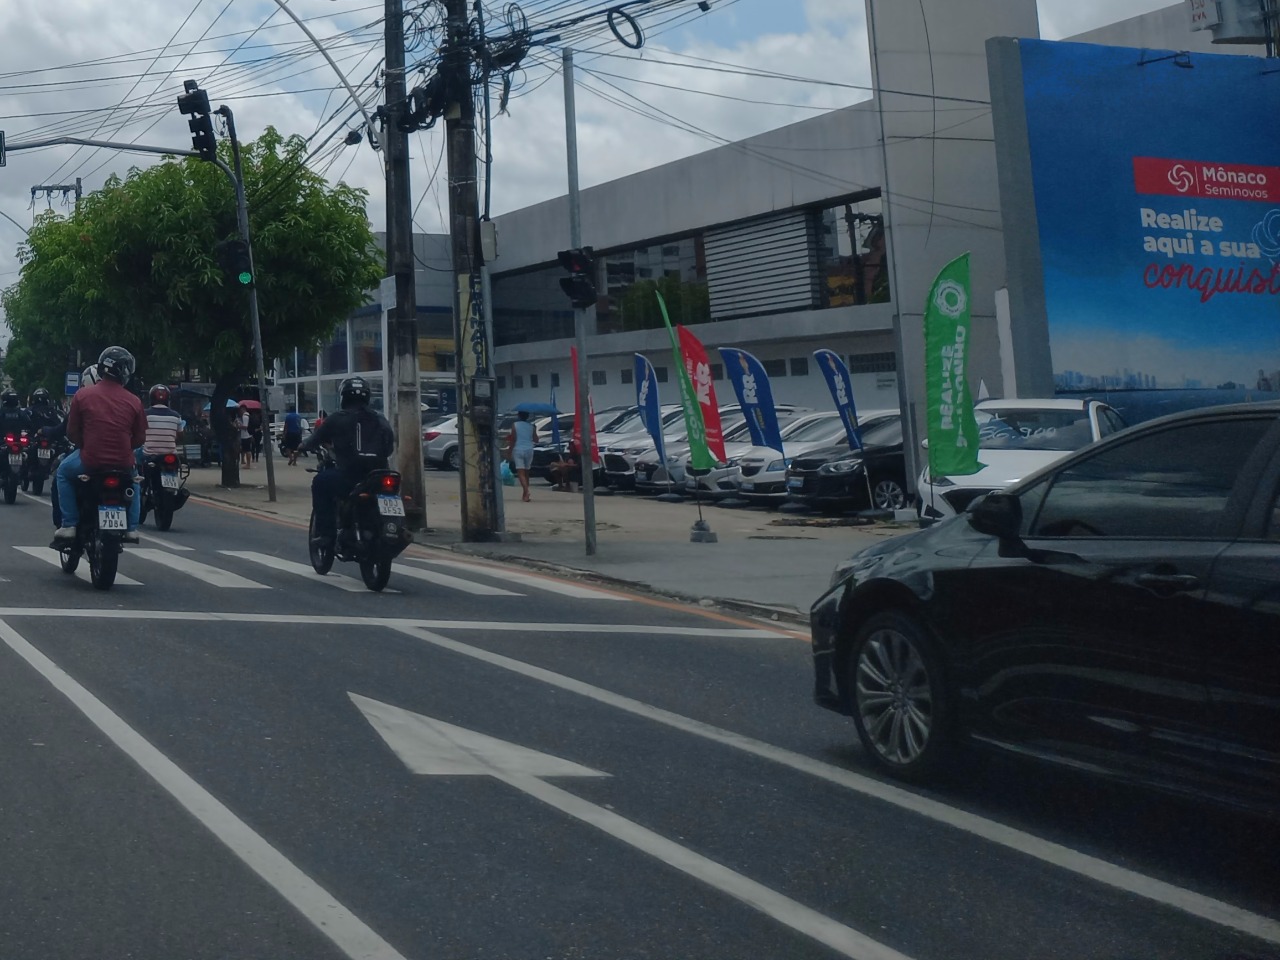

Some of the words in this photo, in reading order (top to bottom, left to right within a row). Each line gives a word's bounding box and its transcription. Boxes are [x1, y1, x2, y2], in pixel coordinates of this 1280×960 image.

[1202, 166, 1267, 185] Mônaco
[1204, 184, 1268, 199] Seminovos
[1140, 207, 1224, 232] Realize
[1143, 232, 1195, 258] aqui
[1200, 239, 1214, 255] a
[1220, 240, 1261, 258] sua
[742, 373, 758, 404] RR
[940, 344, 955, 430] REALIZE
[105, 511, 121, 520] RWT
